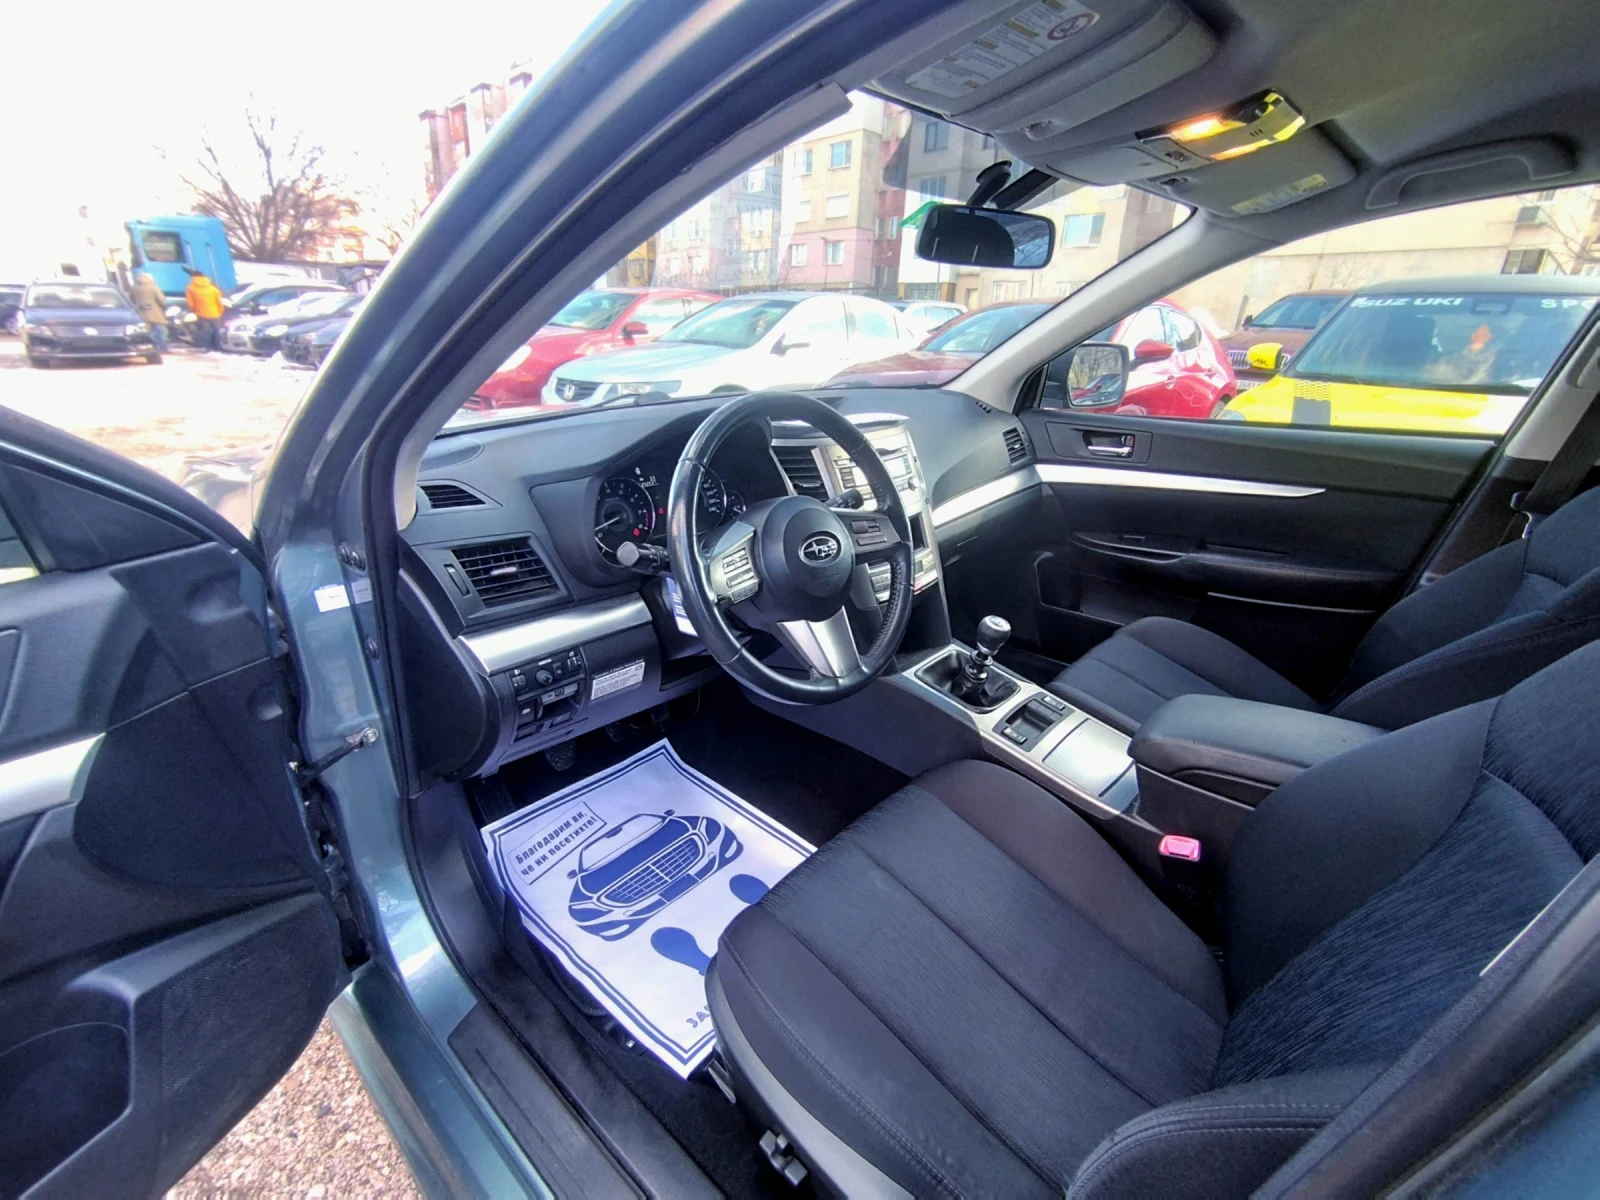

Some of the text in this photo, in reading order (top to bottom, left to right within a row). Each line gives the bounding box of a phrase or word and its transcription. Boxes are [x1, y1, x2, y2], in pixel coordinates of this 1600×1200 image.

[515, 820, 573, 865] Благодарим
[521, 816, 598, 876] че ни посетихте!
[686, 1004, 710, 1028] ЗА
